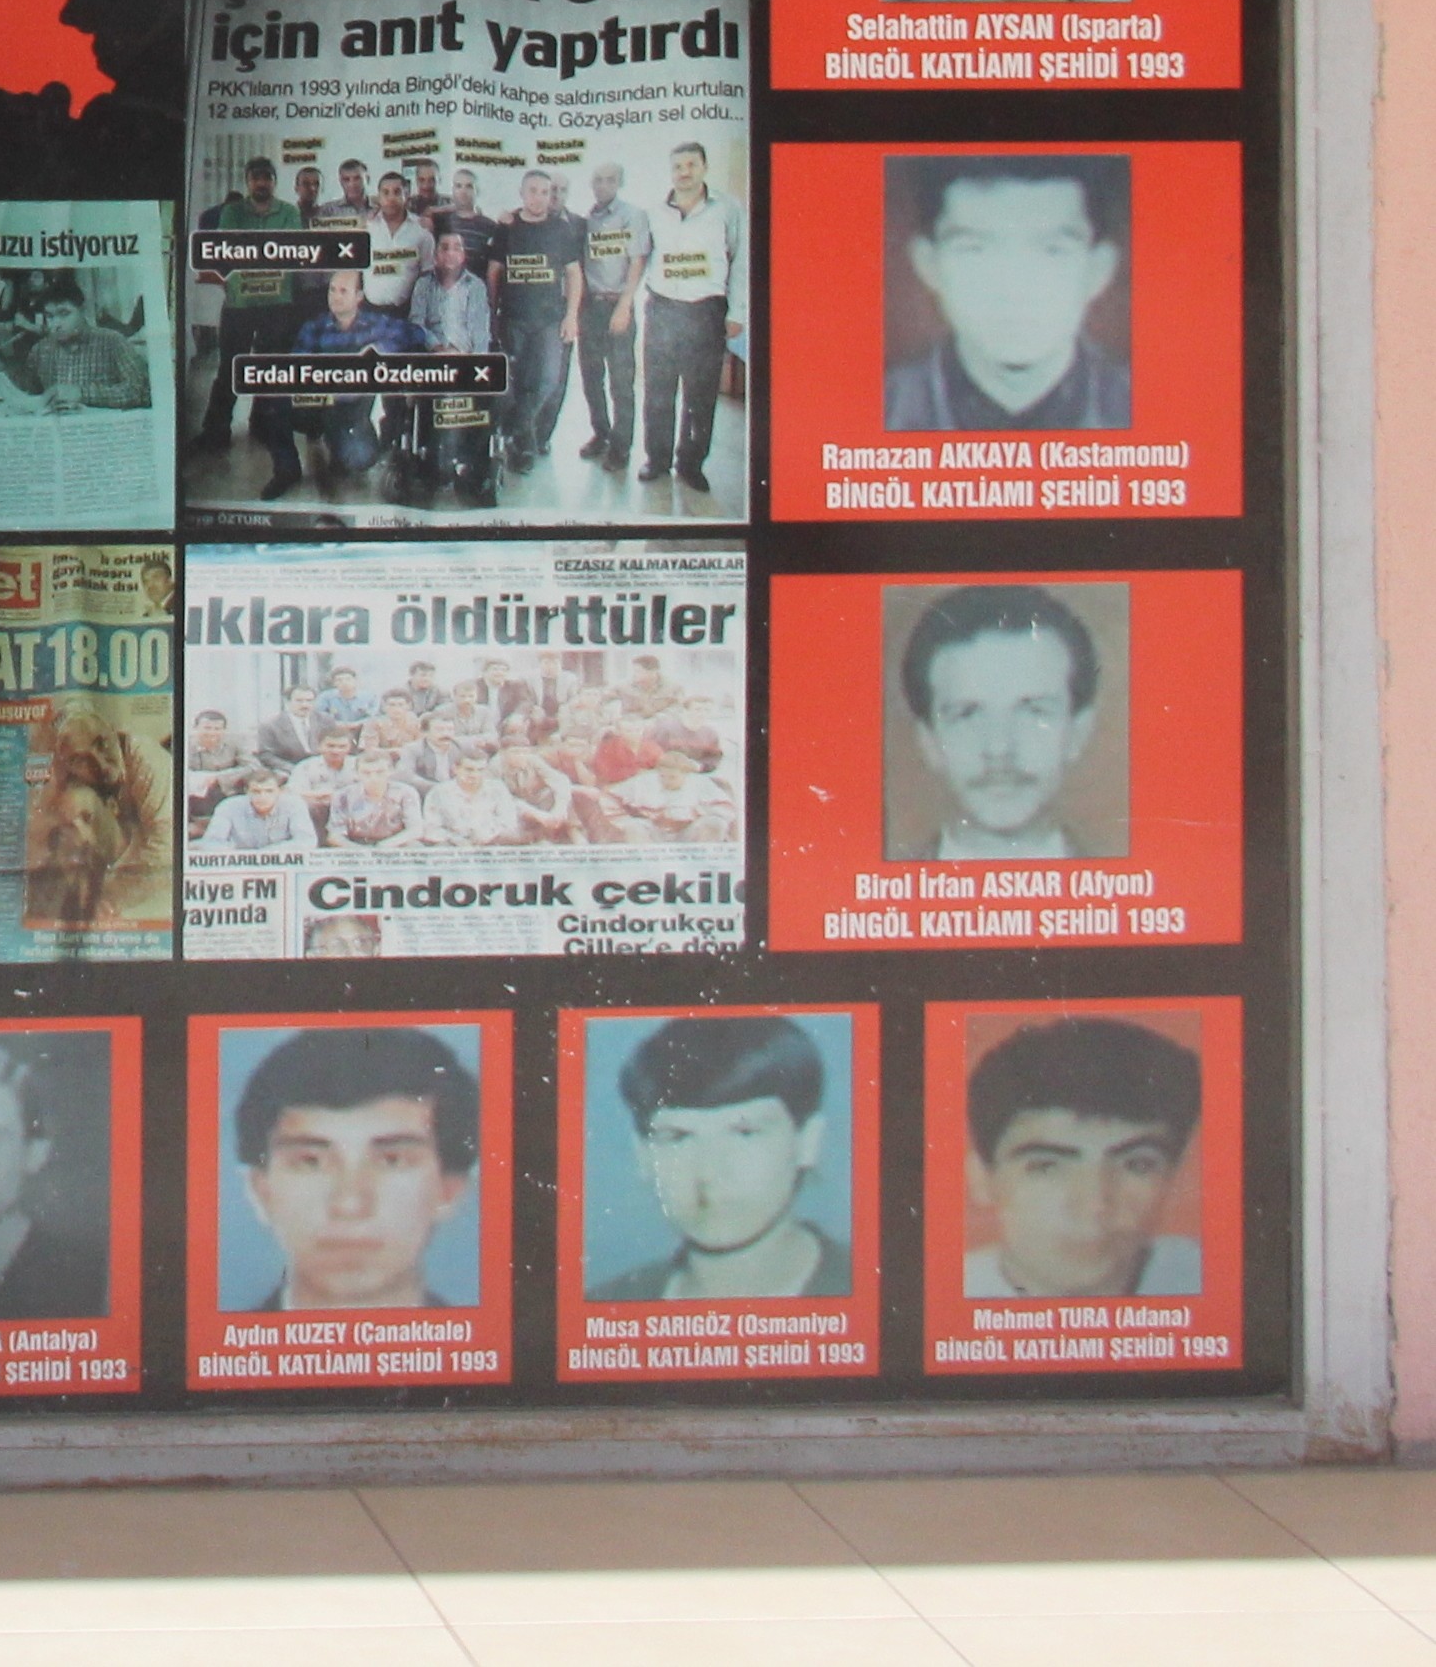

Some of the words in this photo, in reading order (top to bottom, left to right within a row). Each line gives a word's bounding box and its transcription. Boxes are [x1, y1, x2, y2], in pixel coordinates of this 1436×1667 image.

[847, 13, 970, 41] Selahattin
[974, 13, 1056, 41] AYSAN
[1061, 13, 1164, 44] (Isparta)
[39, 230, 141, 263] istiyoruz
[200, 241, 258, 259] Erkan
[262, 241, 322, 263] Omay
[242, 365, 295, 384] Erdal
[299, 365, 369, 384] Fercan
[373, 361, 460, 383] Özdemir
[822, 443, 935, 471] Ramazan
[938, 441, 1035, 470] AKKAYA
[1039, 440, 1191, 471] (Kastamonu)
[391, 593, 737, 645] öldürttüler
[46, 625, 171, 689] 18.00
[307, 869, 574, 910] Cindoruk
[855, 872, 915, 902] Birol
[918, 867, 978, 900] İrfan
[981, 870, 1065, 900] ASKAR
[1069, 869, 1156, 901] (Afyon)
[586, 1316, 641, 1339] Musa
[645, 1311, 733, 1338] SARIGÖZ
[736, 1313, 849, 1338] (Osmaniye)
[973, 1308, 1055, 1331] Mehmet
[1058, 1306, 1110, 1329] TURA
[1115, 1306, 1192, 1329] (Adana)
[8, 1329, 99, 1353] (Antalya)
[223, 1324, 281, 1349] Aydın
[284, 1321, 349, 1346] KUZEY
[353, 1320, 474, 1346] (Çanakkale)
